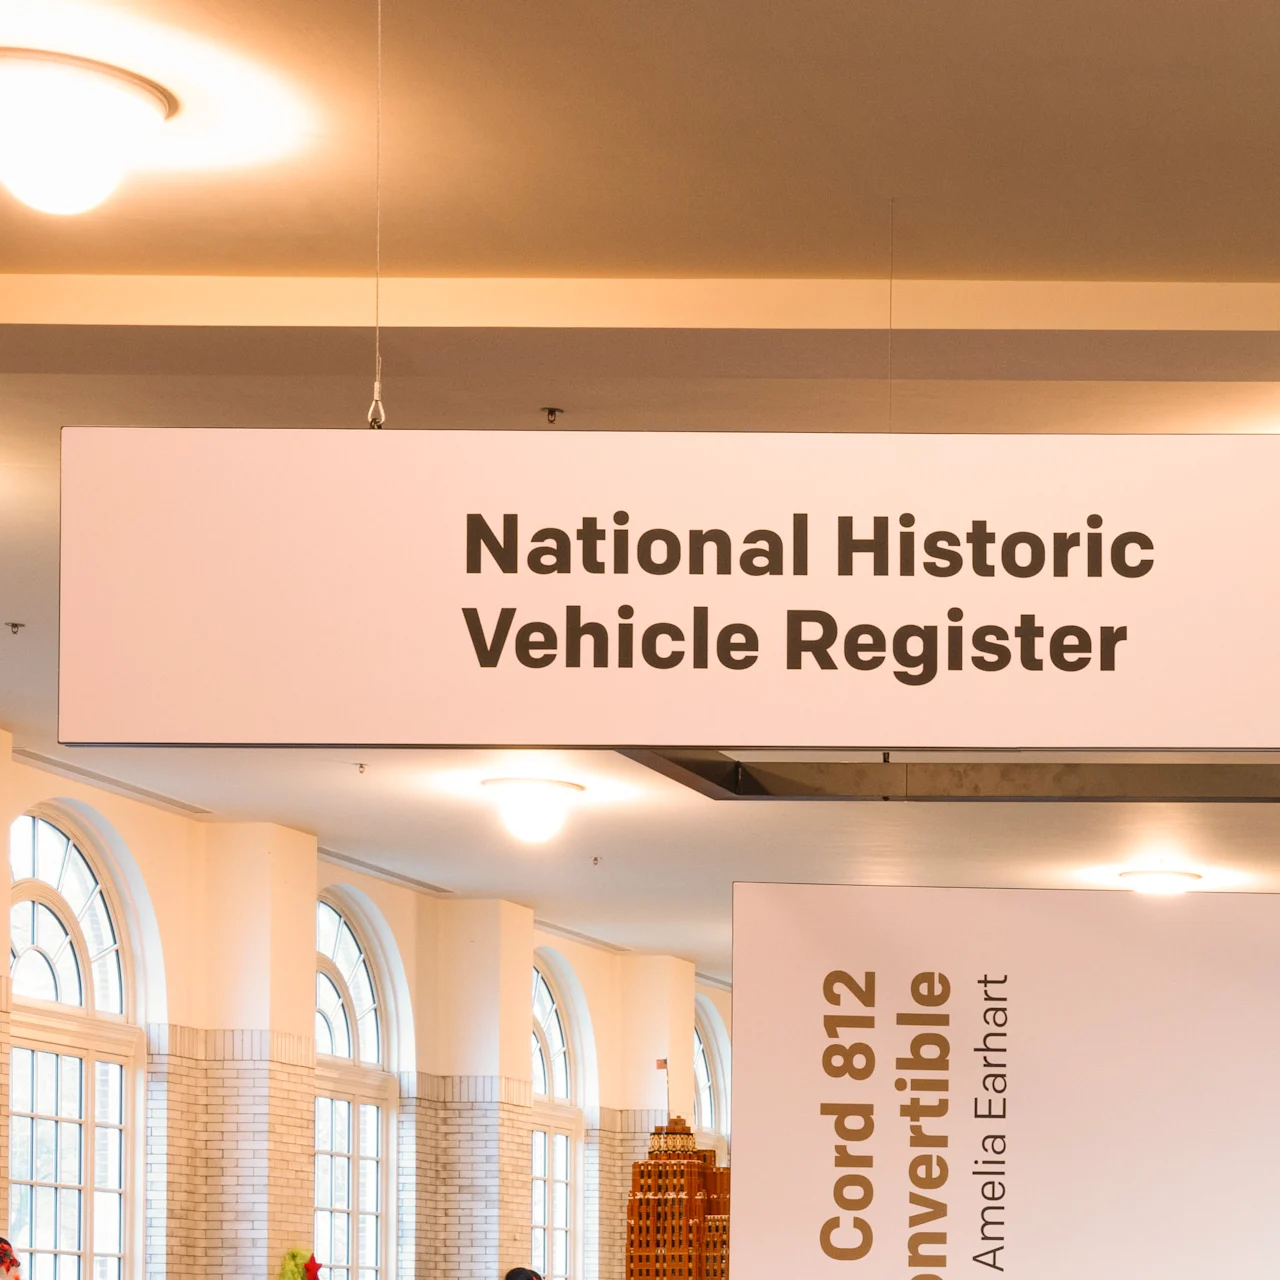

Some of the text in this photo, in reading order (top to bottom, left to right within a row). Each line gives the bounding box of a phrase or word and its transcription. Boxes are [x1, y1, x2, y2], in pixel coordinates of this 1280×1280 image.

[466, 510, 1155, 579] National Historic
[461, 604, 1128, 687] Vehicle Register
[821, 969, 876, 1081] 812
[973, 973, 1009, 1119] Earhart
[819, 1102, 875, 1261] Cord
[971, 1134, 1007, 1272] Amelia
